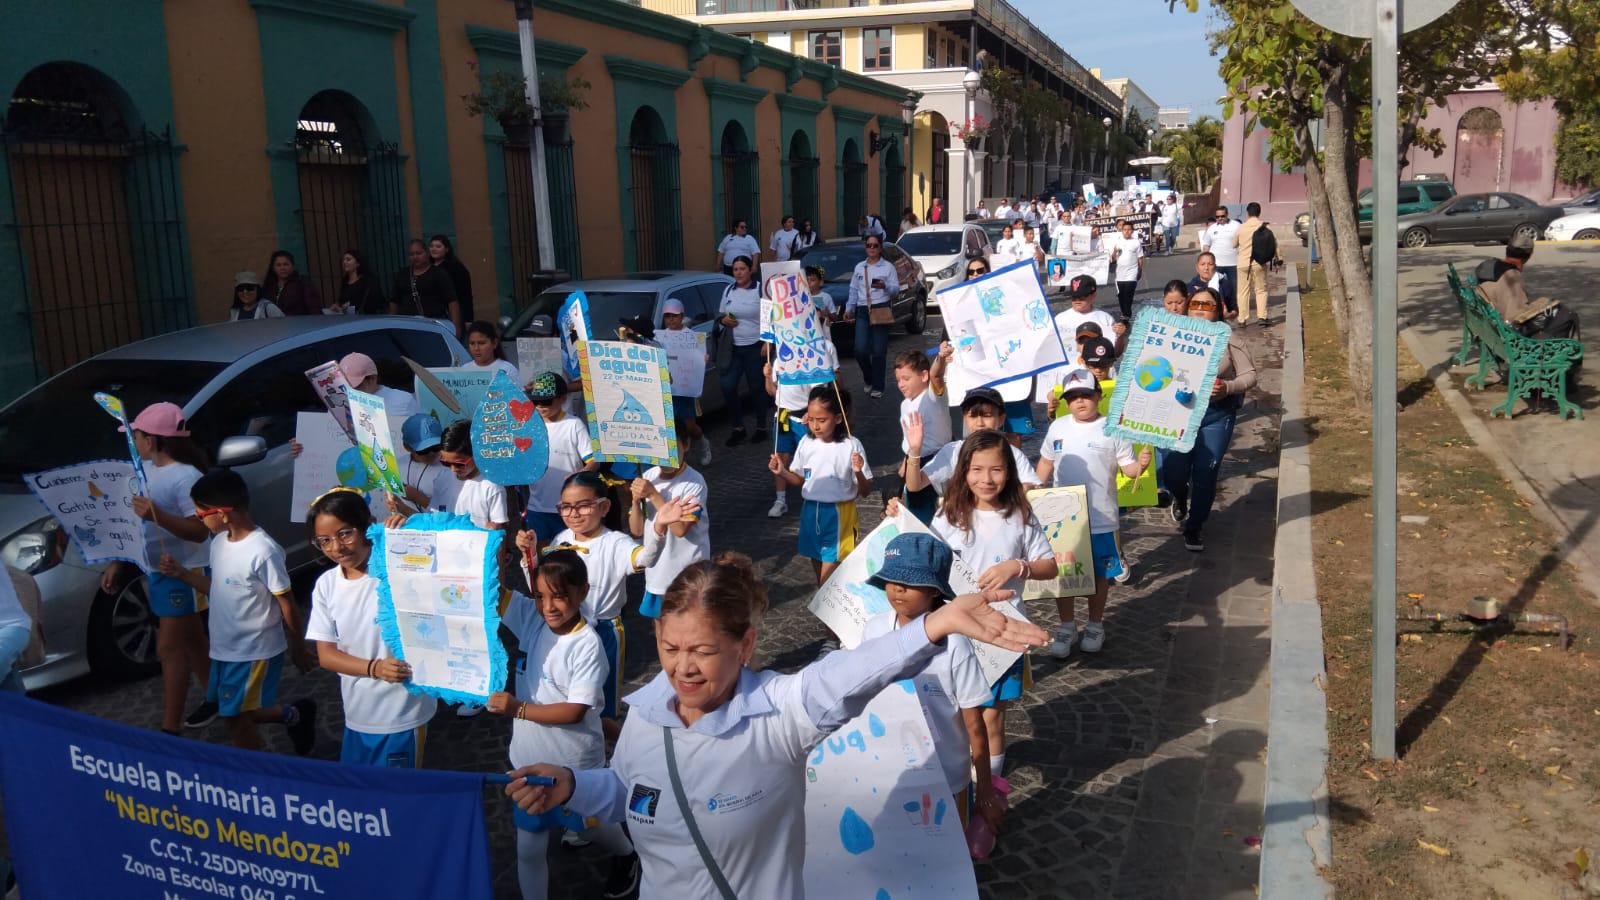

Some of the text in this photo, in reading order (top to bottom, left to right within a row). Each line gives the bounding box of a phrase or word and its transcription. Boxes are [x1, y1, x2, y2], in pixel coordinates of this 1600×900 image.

[770, 299, 804, 321] DEL
[1145, 335, 1206, 357] ES VIDA
[1150, 323, 1212, 347] EL AGUA
[627, 345, 658, 363] del
[598, 359, 648, 375] agua
[442, 378, 476, 388] MUNDIAL
[625, 375, 654, 384] MARZO
[69, 744, 391, 837] Escuela Primaria Federal
[122, 853, 167, 882] Zona
[169, 866, 235, 899] Escolar
[150, 837, 325, 895] C.C.T. 25DPR0977L
